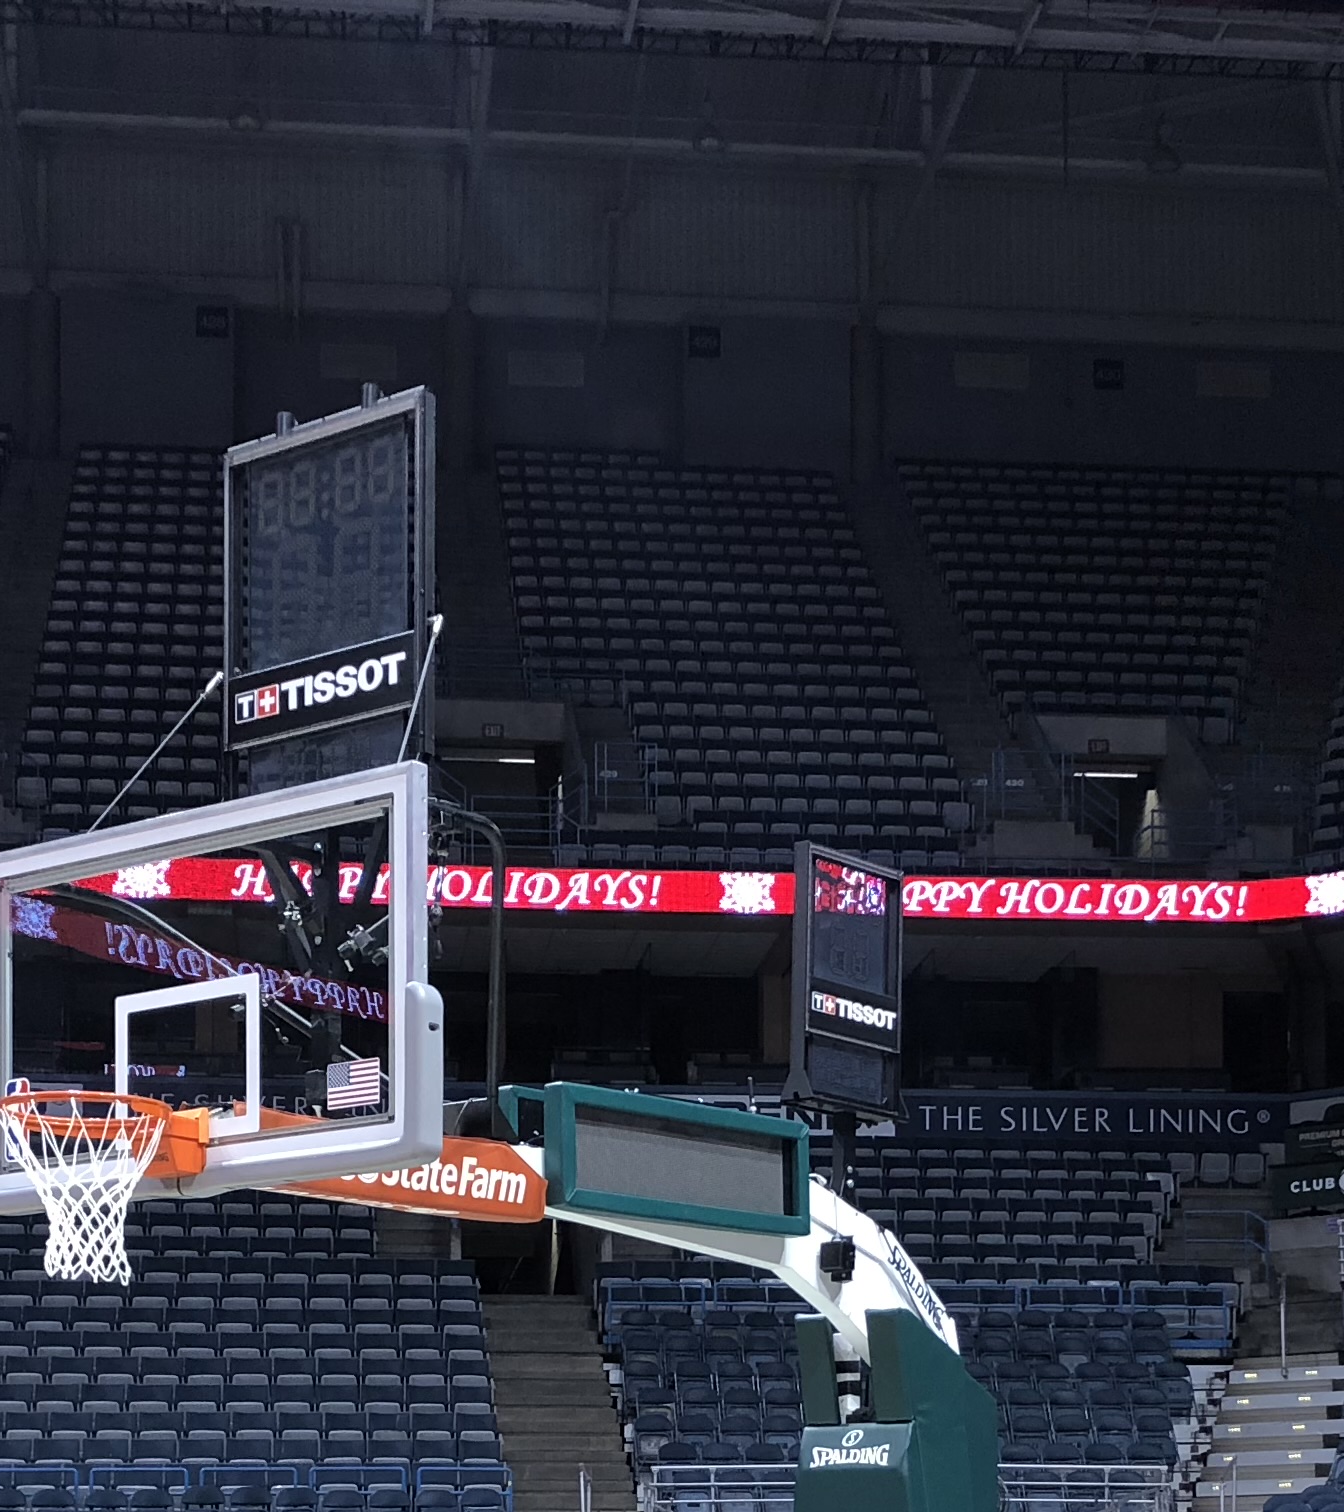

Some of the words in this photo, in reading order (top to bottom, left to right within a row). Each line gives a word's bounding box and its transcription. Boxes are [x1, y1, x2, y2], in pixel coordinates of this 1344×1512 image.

[280, 651, 406, 711] TISSOT
[902, 878, 996, 914] PPY
[996, 879, 1249, 921] HOLIDAYS!
[835, 998, 897, 1031] TISSOT
[918, 1105, 984, 1132] THE
[1000, 1106, 1112, 1133] SILVER
[1289, 1177, 1336, 1194] CLUB
[887, 1245, 944, 1332] SPALDING
[809, 1443, 890, 1469] SPALDING
